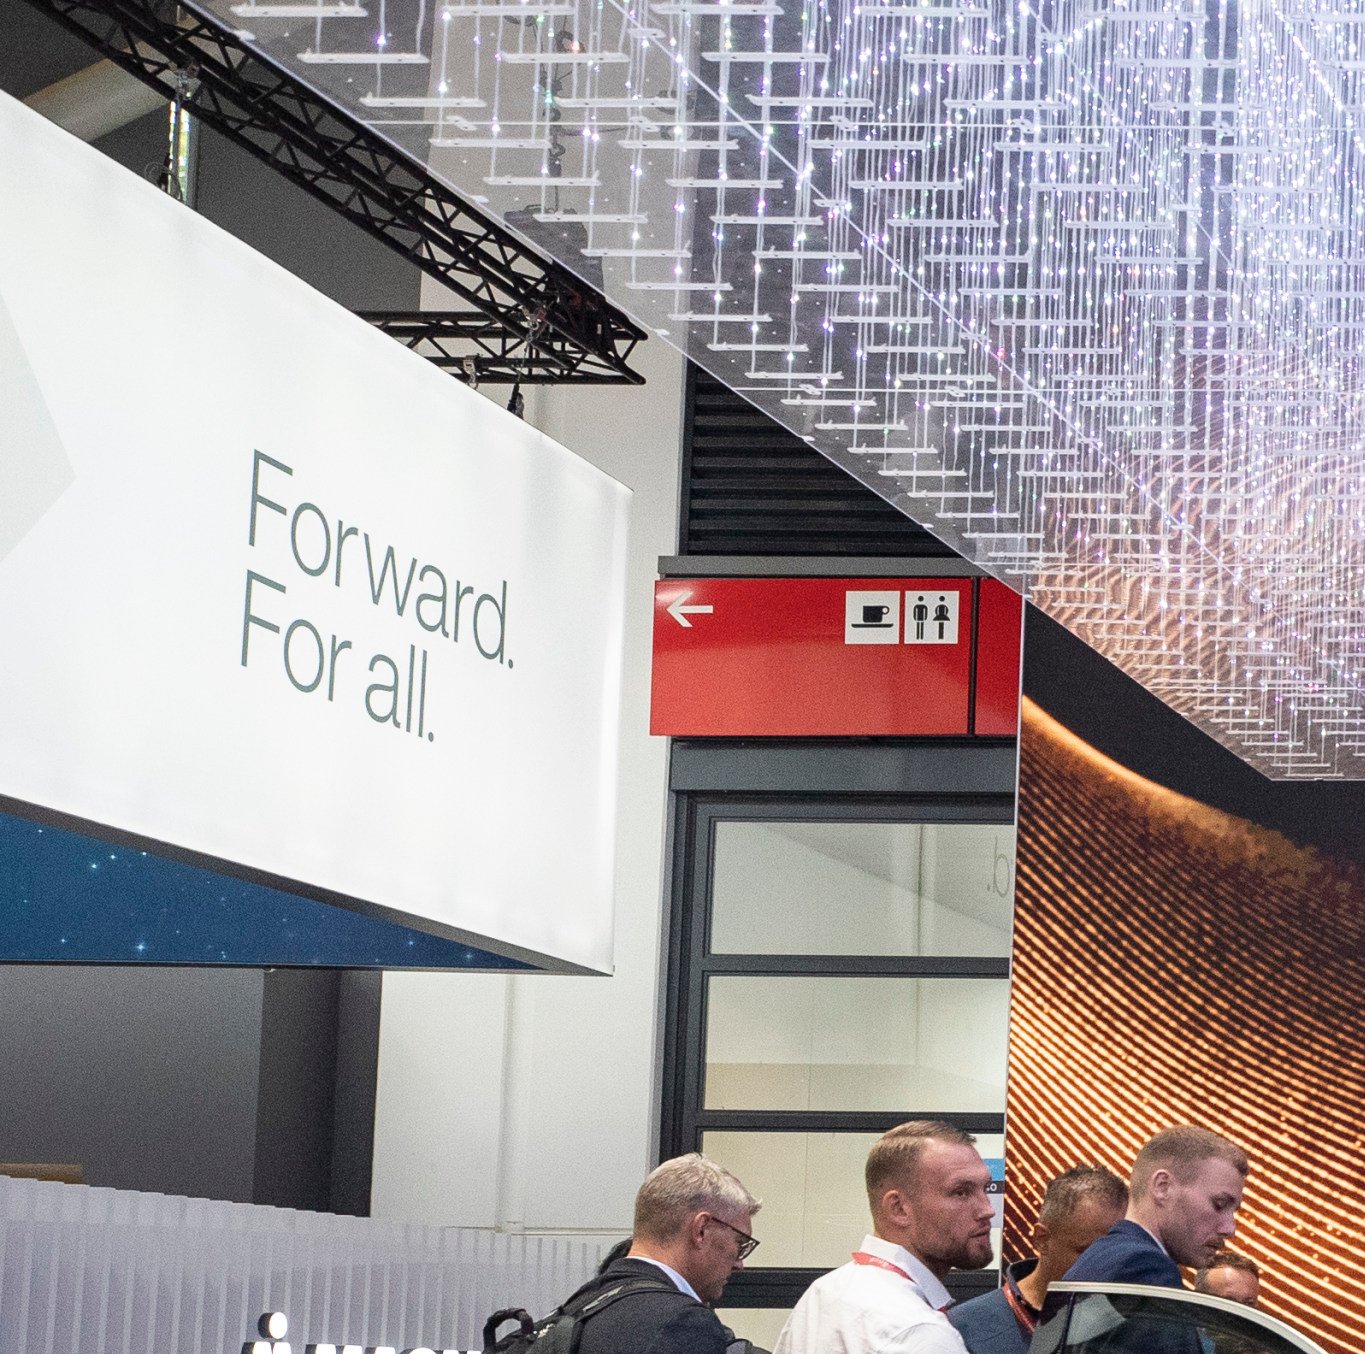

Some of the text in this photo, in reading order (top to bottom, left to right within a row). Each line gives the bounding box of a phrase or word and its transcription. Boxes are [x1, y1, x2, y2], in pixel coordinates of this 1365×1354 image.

[241, 569, 435, 743] For all.
[248, 449, 516, 670] Forward.
